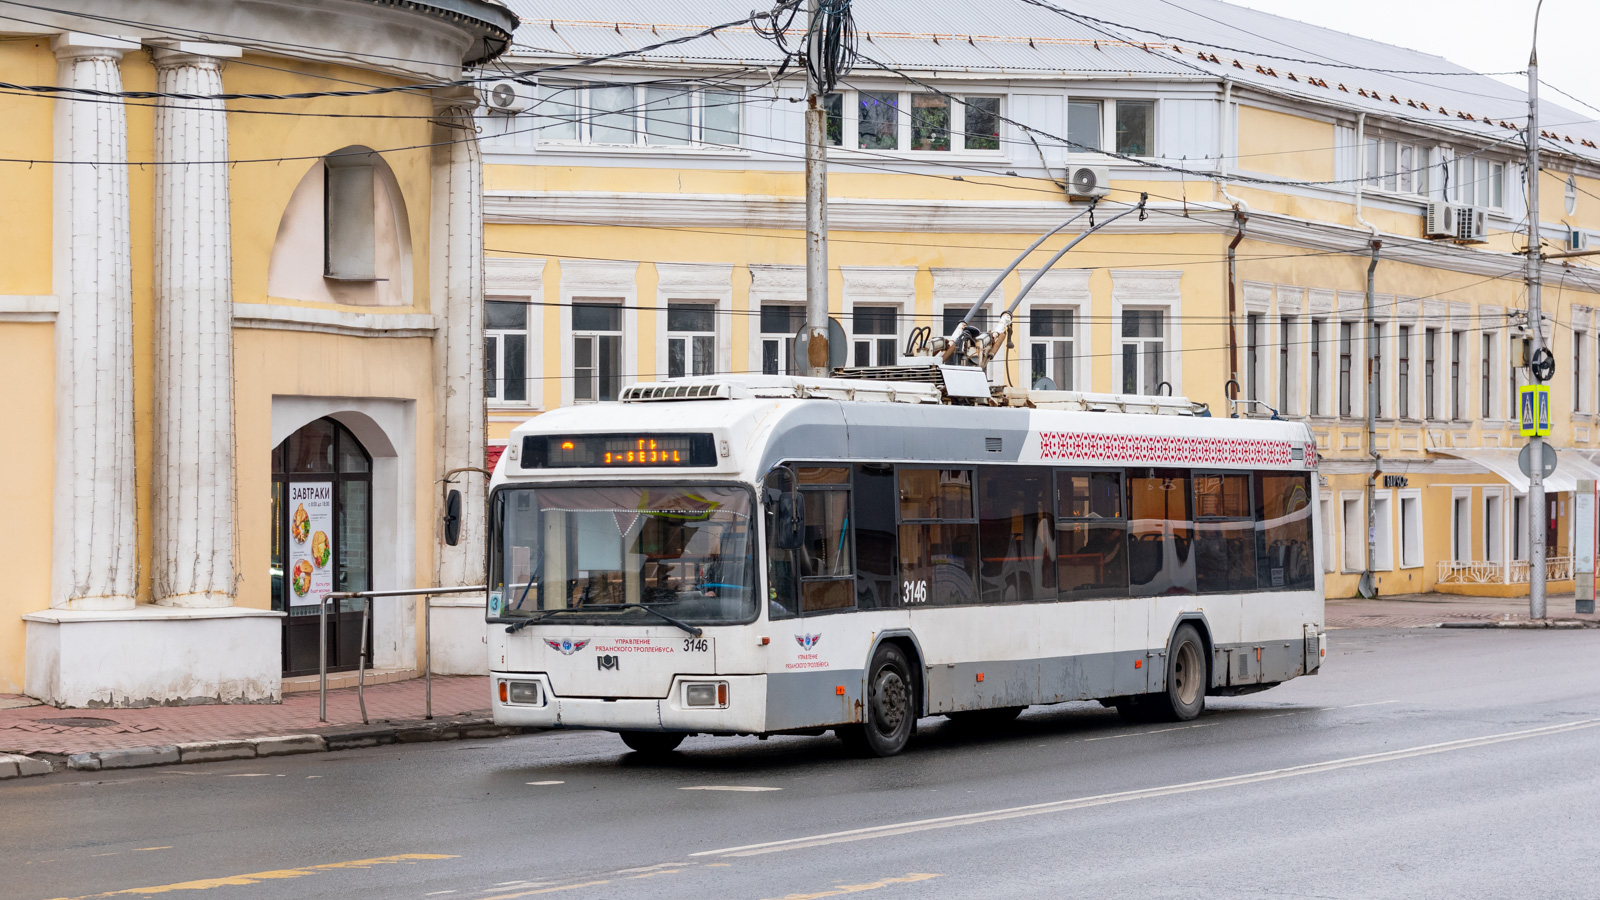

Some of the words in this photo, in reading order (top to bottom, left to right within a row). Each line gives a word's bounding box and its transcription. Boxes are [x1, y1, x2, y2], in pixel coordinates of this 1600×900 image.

[292, 487, 330, 500] ЗАВТРАКИ
[903, 580, 927, 603] 3146
[492, 597, 499, 611] 3
[595, 645, 633, 653] РЯЗАНСКОГО
[633, 645, 675, 653] ТРОЛЛЕЙБУСА
[683, 638, 708, 652] 3146
